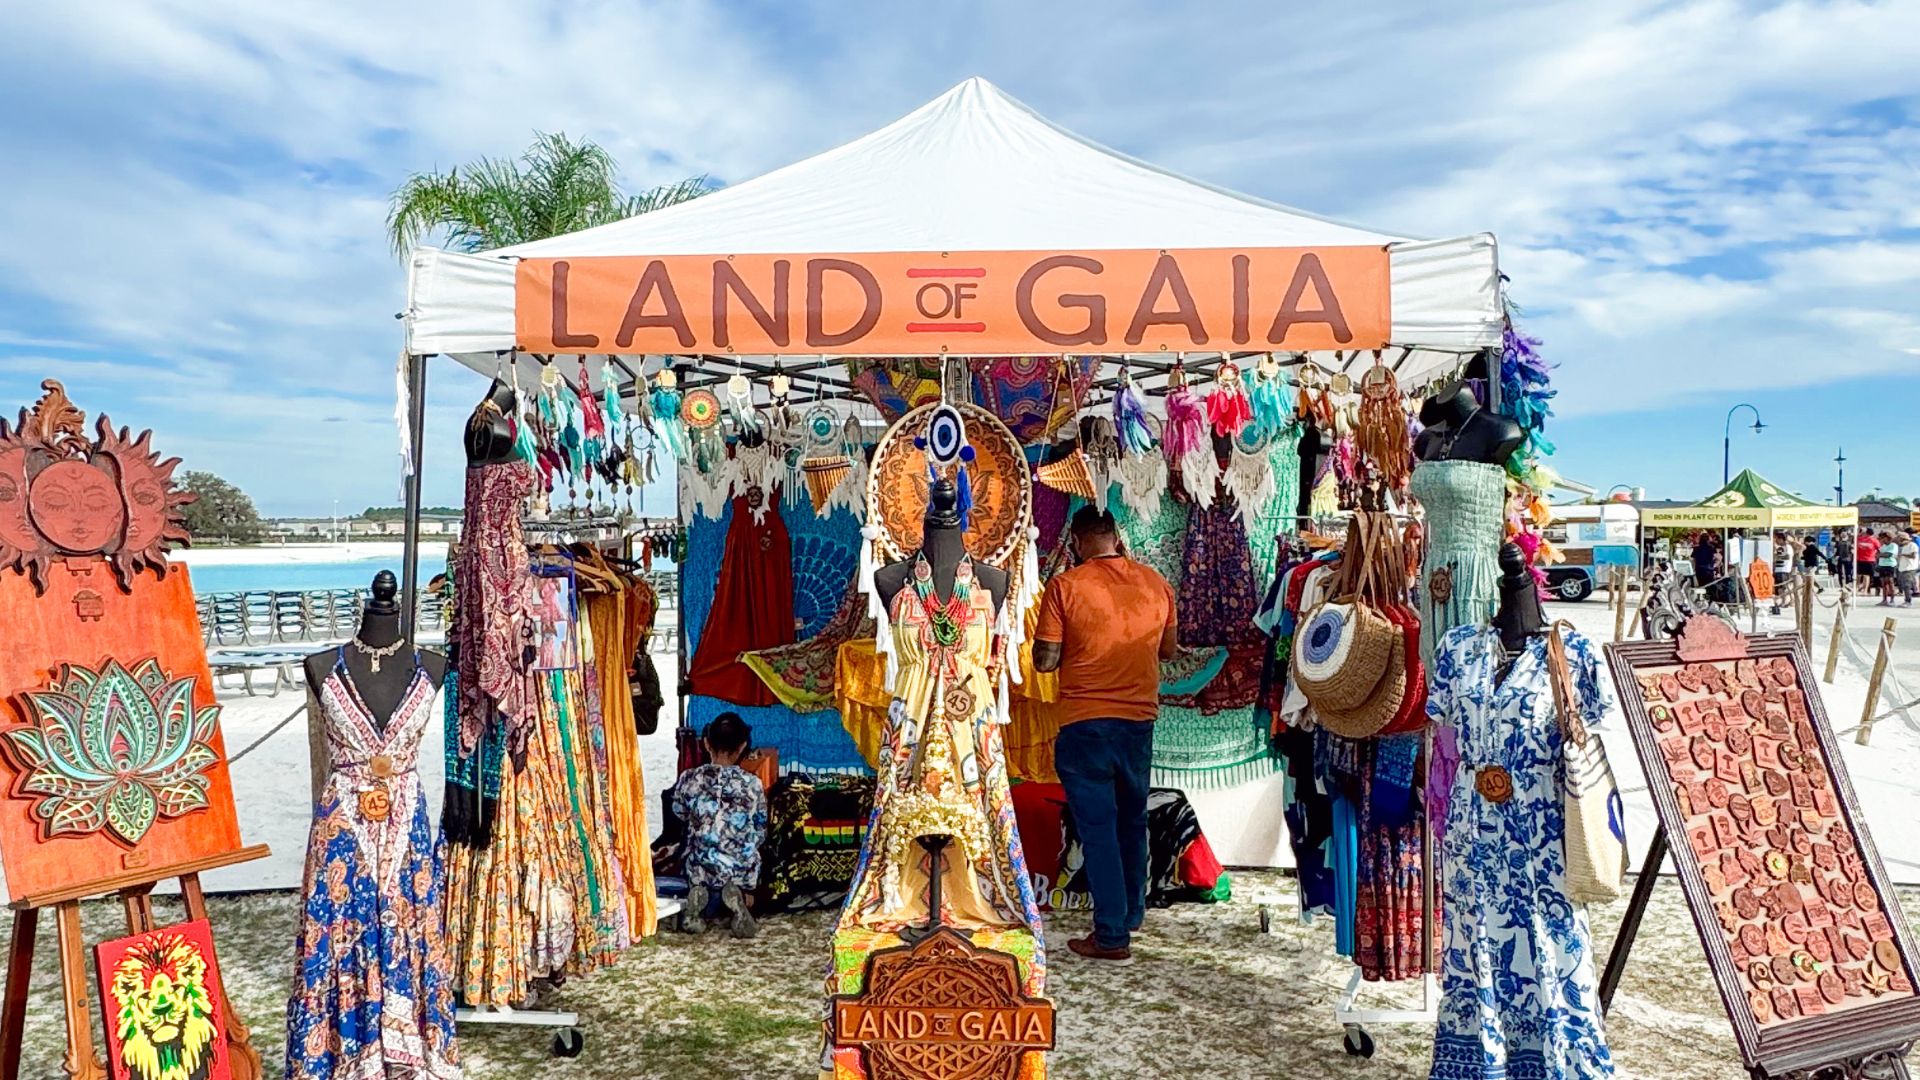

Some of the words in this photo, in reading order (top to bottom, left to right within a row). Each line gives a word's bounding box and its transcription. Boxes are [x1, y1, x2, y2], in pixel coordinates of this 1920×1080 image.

[551, 257, 883, 349] LAND
[915, 282, 978, 320] OF
[1015, 252, 1354, 347] GAIA
[1653, 513, 1673, 521] BORN
[1683, 513, 1706, 521] PLANT
[1727, 513, 1758, 521] FLORIDA
[947, 694, 968, 712] 45
[1486, 774, 1504, 792] 40
[368, 794, 388, 811] 45
[802, 819, 855, 845] ONE
[840, 1008, 927, 1039] LAND
[934, 1017, 952, 1032] OF
[960, 1011, 1046, 1041] GAIA
